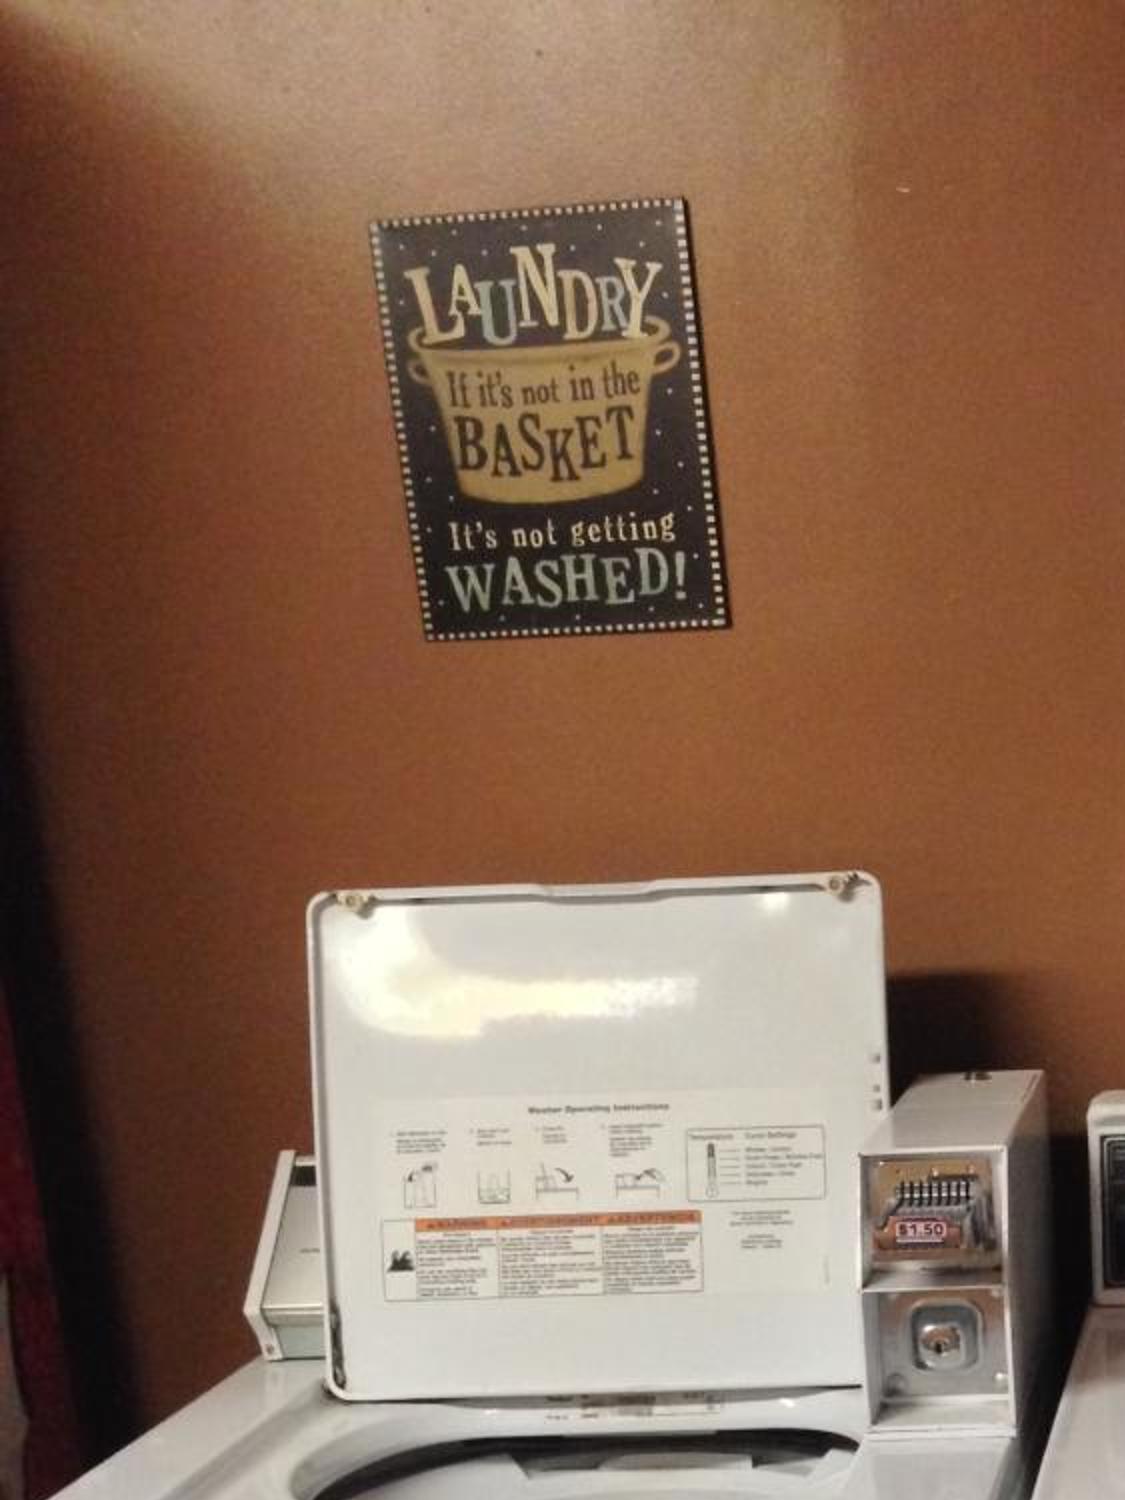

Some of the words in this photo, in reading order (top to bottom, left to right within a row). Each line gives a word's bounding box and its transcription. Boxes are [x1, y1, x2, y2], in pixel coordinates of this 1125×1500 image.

[404, 243, 663, 346] LAUNDRY
[446, 370, 472, 409] If
[476, 366, 514, 410] it's
[521, 377, 559, 408] not
[569, 364, 595, 402] in
[602, 360, 641, 399] the
[454, 404, 635, 483] BASKET
[449, 520, 497, 551] It's
[512, 519, 557, 548] not
[570, 512, 676, 547] getting
[445, 546, 687, 614] WASHED!
[898, 1222, 944, 1236] $1.50
